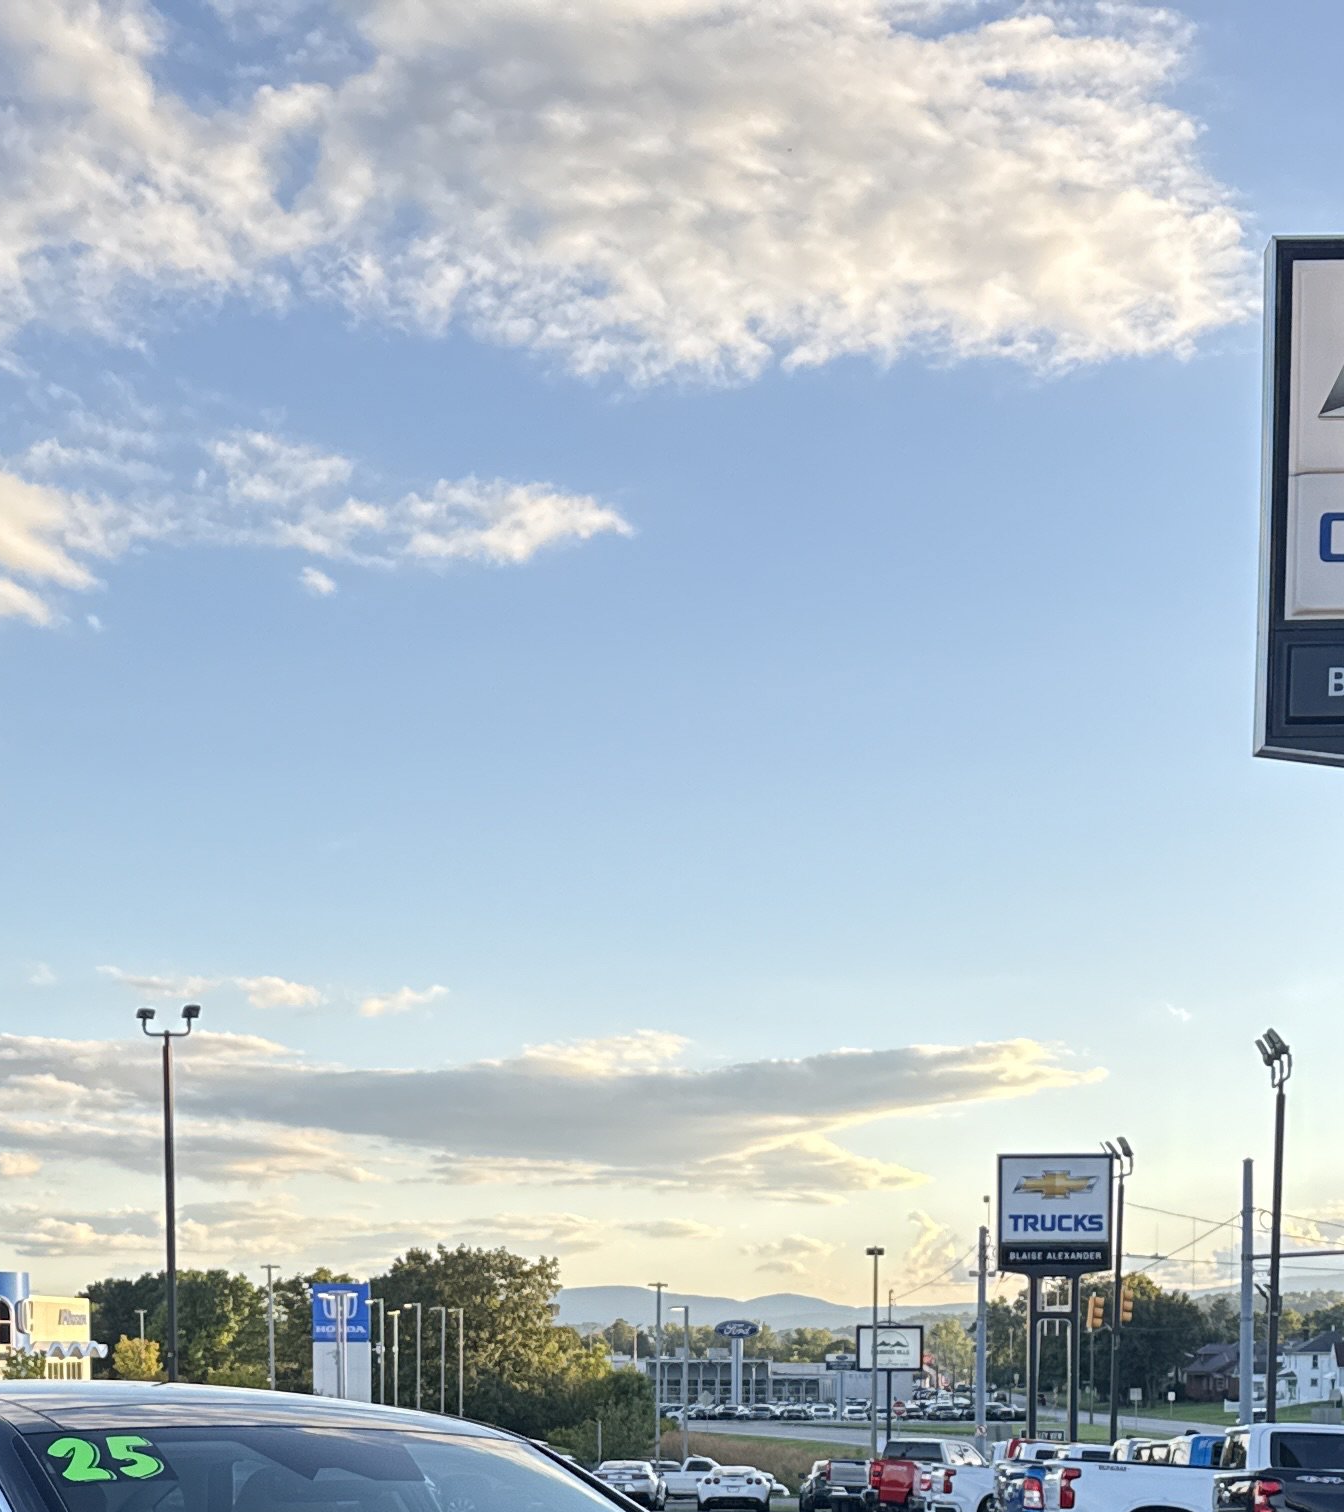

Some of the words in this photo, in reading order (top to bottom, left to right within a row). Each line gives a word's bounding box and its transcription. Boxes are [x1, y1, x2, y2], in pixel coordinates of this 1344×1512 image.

[1008, 1214, 1104, 1232] TRUCKS
[1009, 1251, 1043, 1260] BLAISE
[1046, 1251, 1102, 1260] ALEXANDER
[316, 1325, 366, 1333] HODA
[723, 1323, 752, 1335] Ford
[47, 1435, 165, 1482] 25
